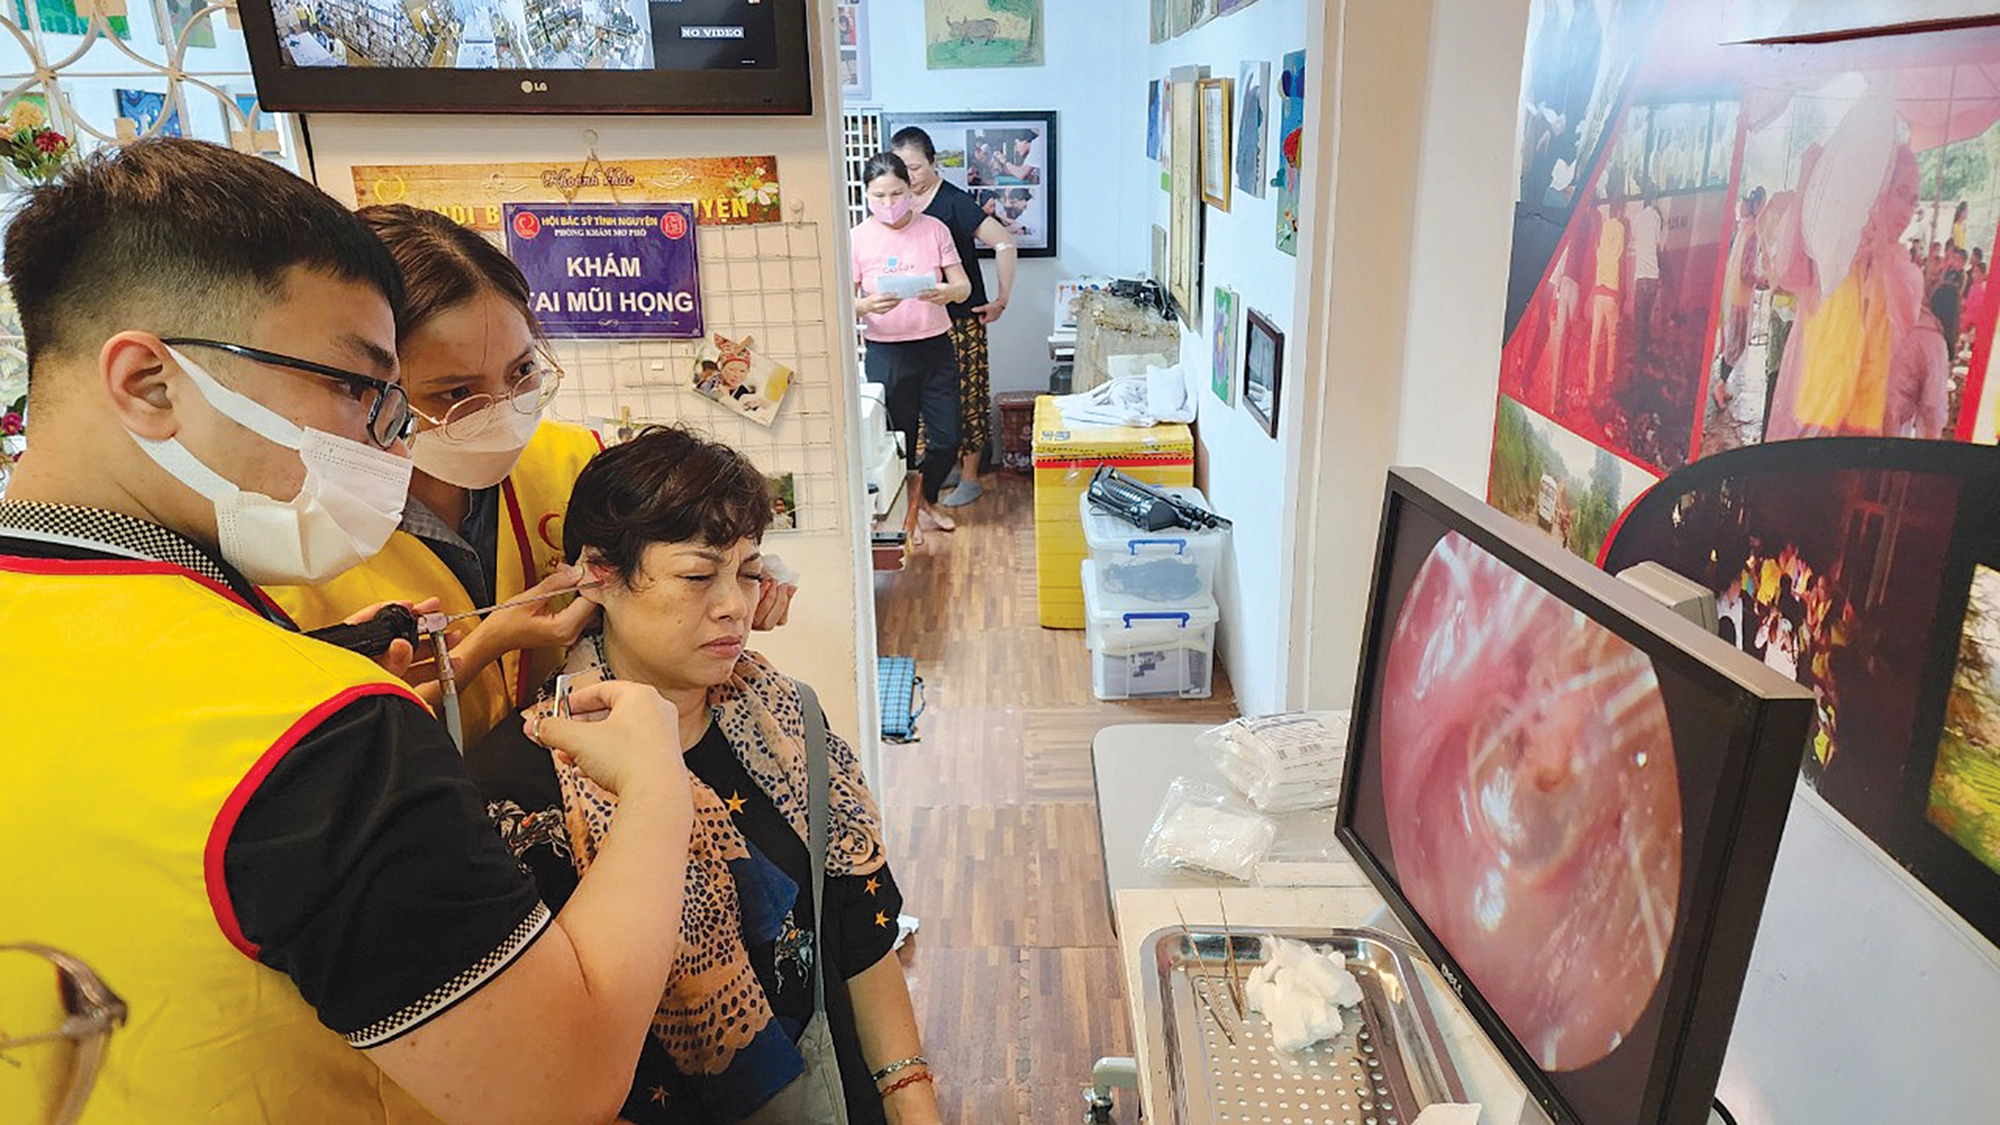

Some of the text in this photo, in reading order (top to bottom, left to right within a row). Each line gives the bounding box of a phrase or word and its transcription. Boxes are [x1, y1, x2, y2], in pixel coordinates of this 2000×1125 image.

[682, 28, 743, 38] NO VIDEO
[534, 82, 548, 91] LG
[541, 215, 559, 228] HỘI
[560, 214, 579, 226] BÁC
[567, 252, 641, 277] KHÁM
[567, 287, 612, 312] MŨI
[619, 291, 693, 316] HỌNG
[1441, 963, 1464, 998] DELL
